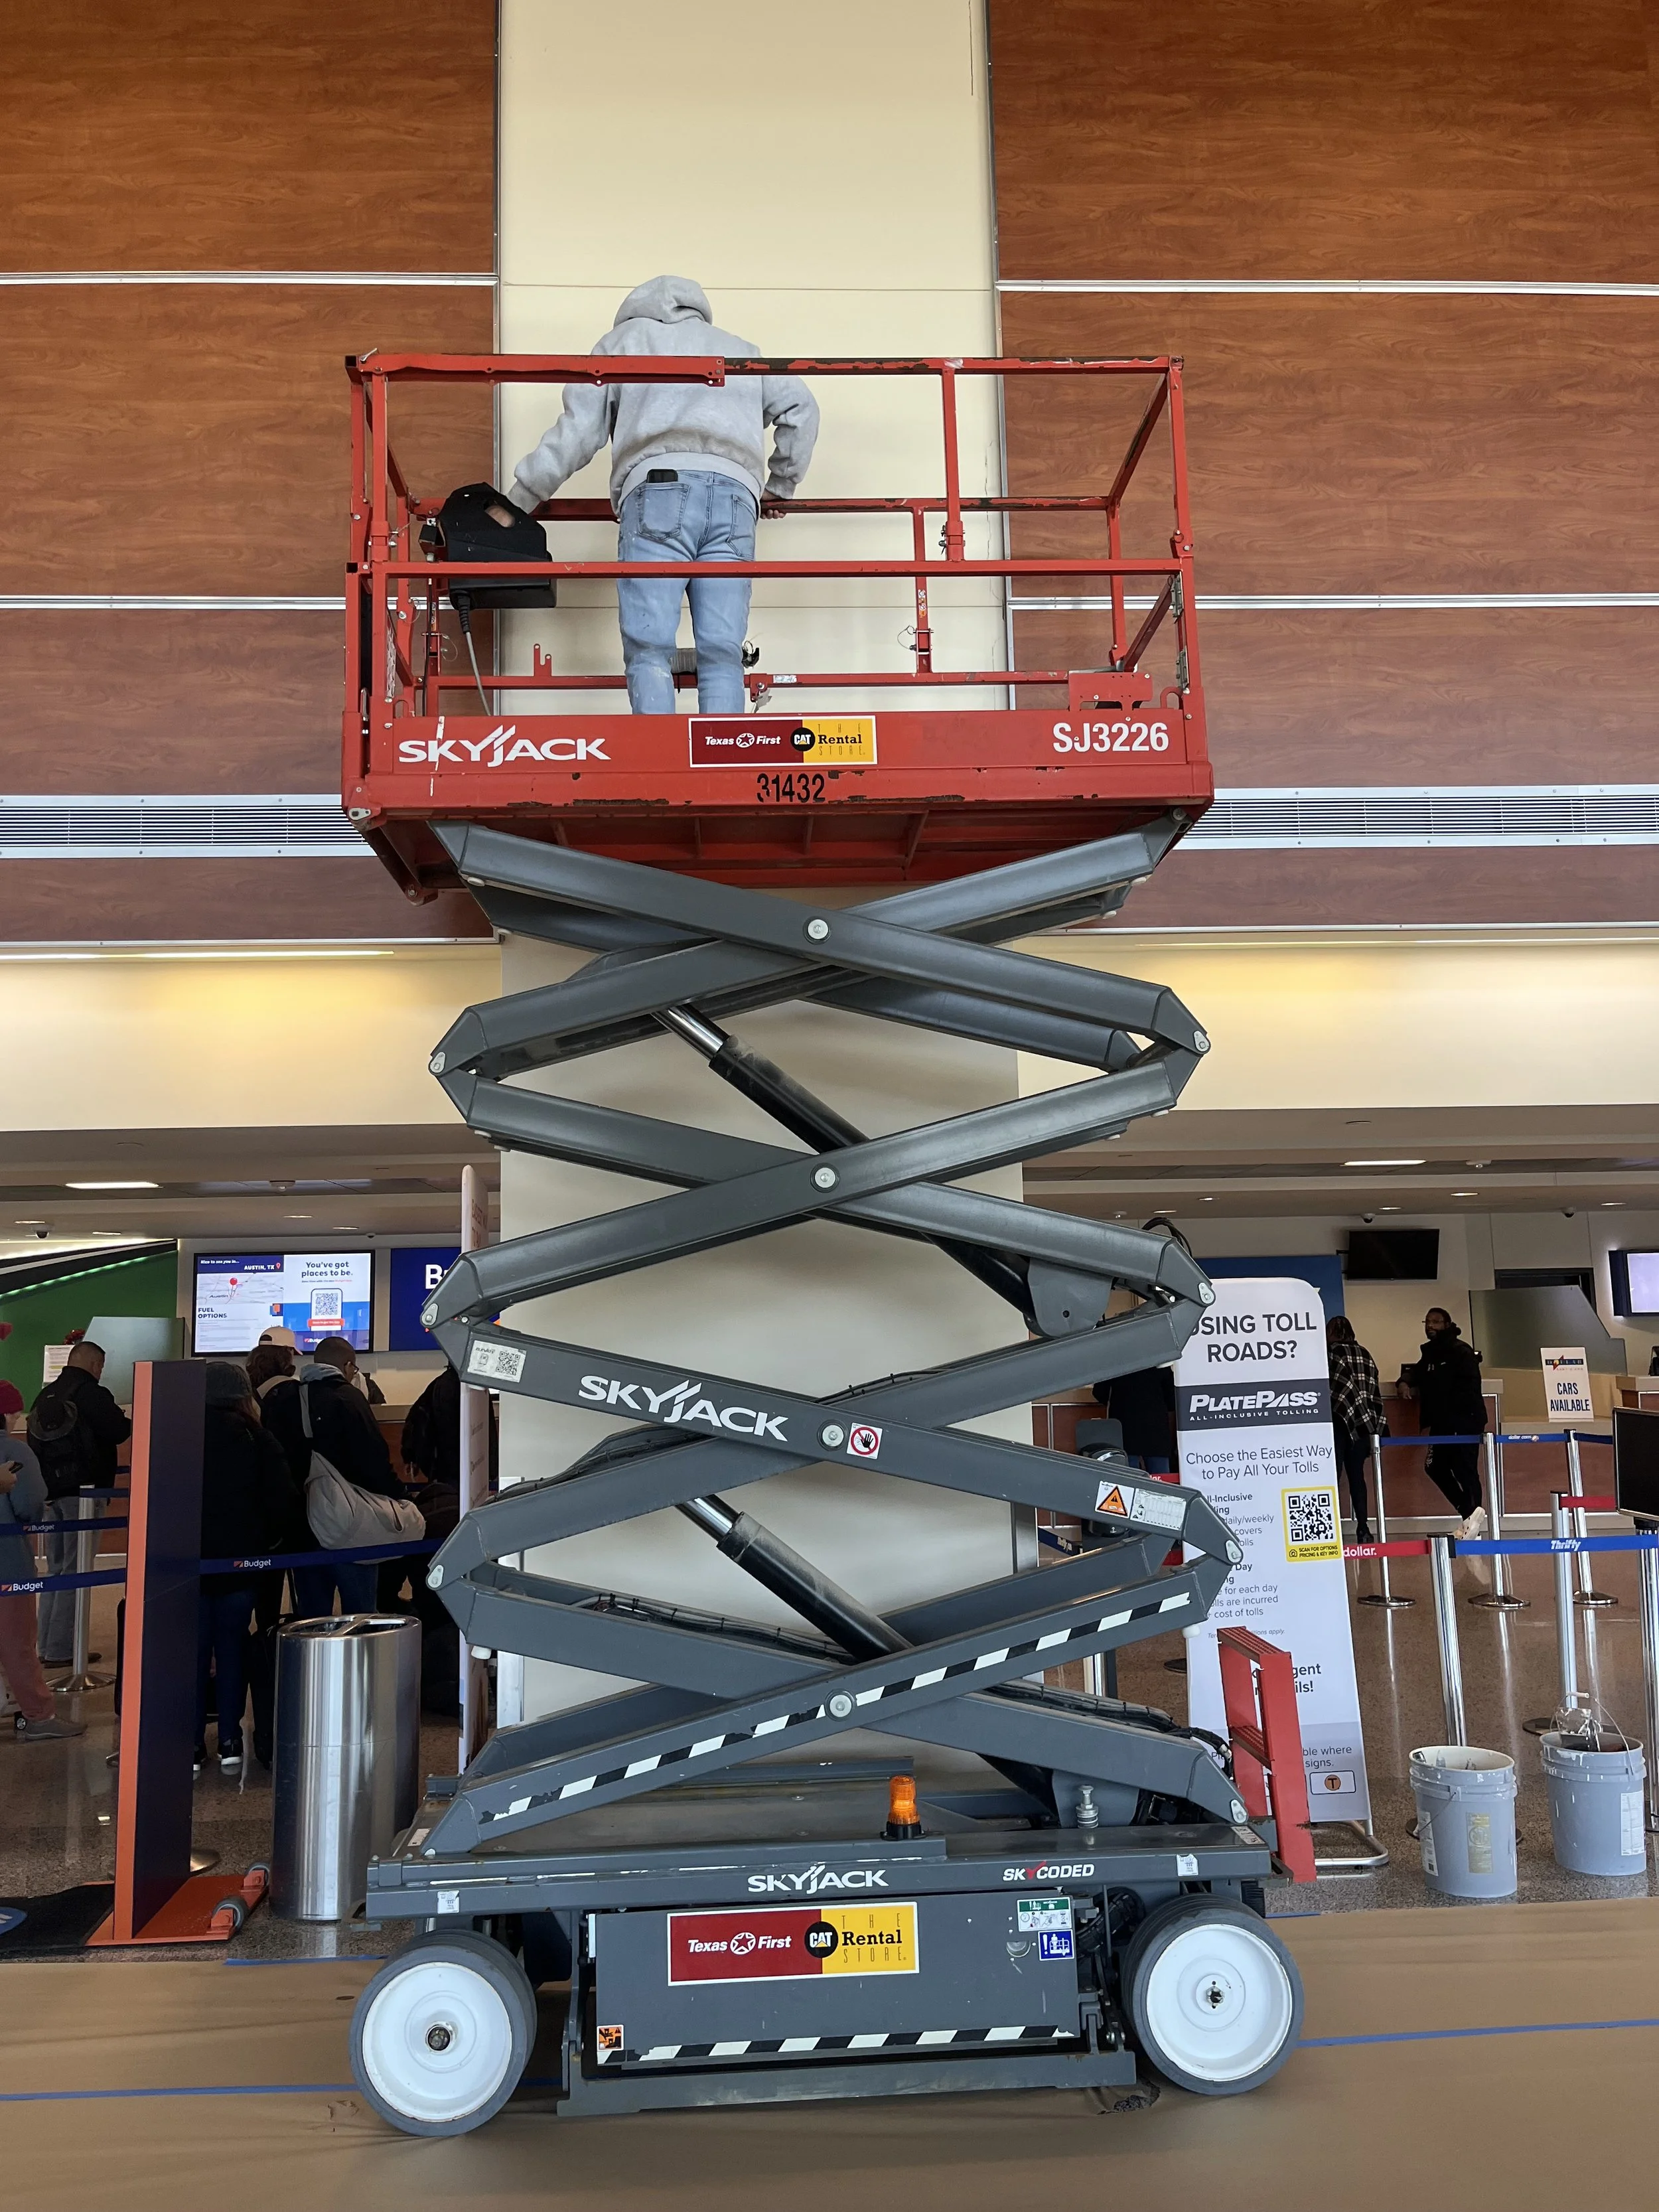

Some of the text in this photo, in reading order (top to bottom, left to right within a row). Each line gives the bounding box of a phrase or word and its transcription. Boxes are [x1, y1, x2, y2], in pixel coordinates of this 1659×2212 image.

[705, 735, 781, 745] Texas First
[794, 734, 811, 745] CAT
[818, 734, 862, 745] Rental
[1053, 722, 1169, 753] SJ3226
[398, 725, 611, 767] SKYJACK
[757, 773, 826, 803] 31432
[1262, 1312, 1317, 1333] TOLL
[1207, 1340, 1297, 1363] ROADS?
[1557, 1382, 1579, 1395] CARS
[578, 1375, 788, 1442] SKYJACK
[1550, 1399, 1591, 1412] AVAILABLE
[1190, 1411, 1269, 1421] ALL-INCLUSIVE
[1186, 1445, 1333, 1465] Choose the Easiest Way
[1202, 1461, 1319, 1480] to Pay All Your Tolls
[1206, 1493, 1253, 1503] ll-Inclusive
[1551, 1539, 1581, 1552] Thrifty
[244, 1559, 271, 1568] Budget
[1236, 1563, 1252, 1572] Day
[13, 1582, 43, 1591] Budget
[1239, 1584, 1260, 1593] each
[1262, 1584, 1278, 1593] day
[1243, 1595, 1279, 1605] incurred
[1214, 1609, 1233, 1618] cost
[1235, 1608, 1244, 1617] of
[1246, 1607, 1264, 1616] tolls
[1321, 1745, 1352, 1755] where
[1305, 1758, 1334, 1769] signs.
[1003, 1860, 1095, 1881] SKYCODED
[748, 1864, 889, 1895] SKYJACK
[688, 1935, 792, 1953] Texas First
[810, 1932, 832, 1948] CAT
[841, 1930, 902, 1946] Rental
